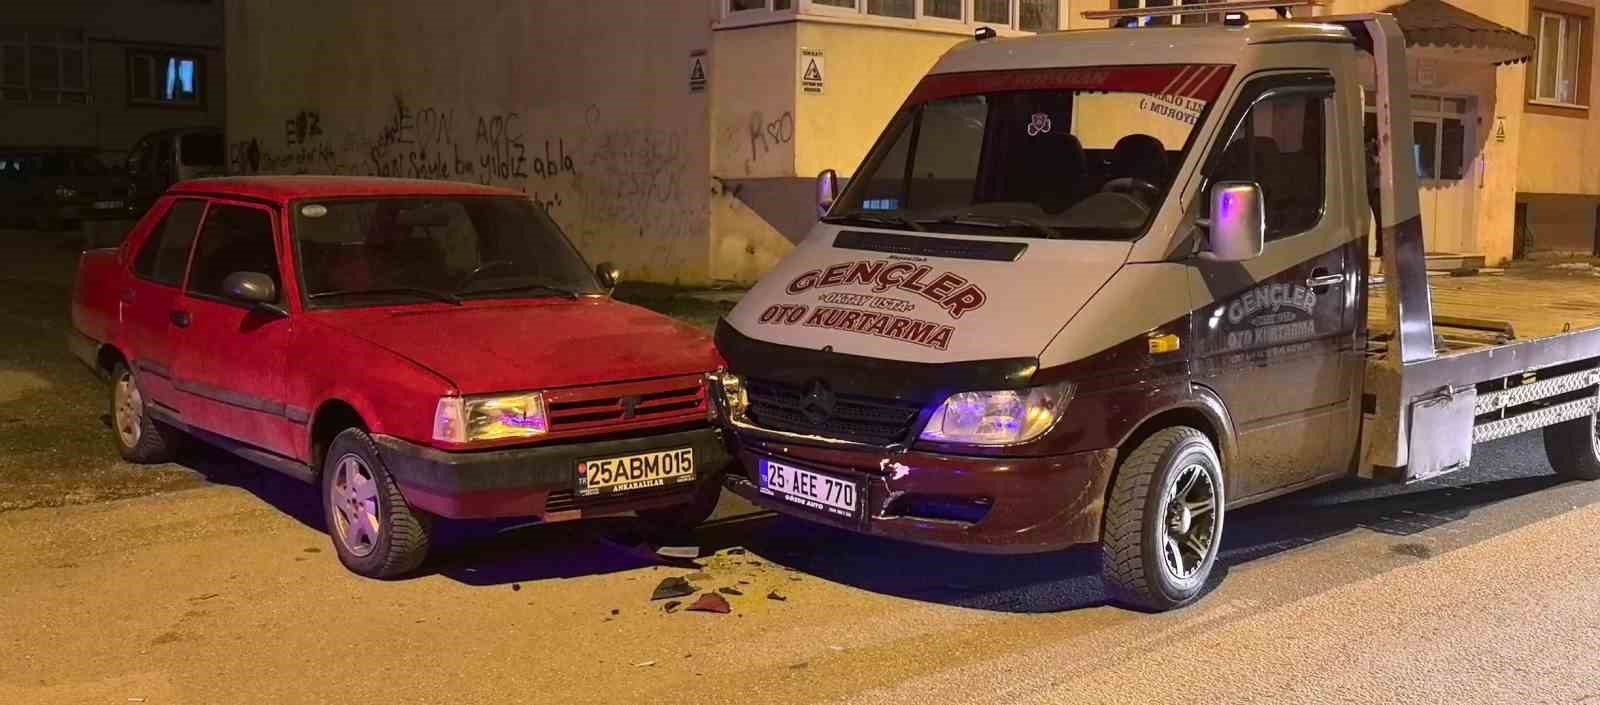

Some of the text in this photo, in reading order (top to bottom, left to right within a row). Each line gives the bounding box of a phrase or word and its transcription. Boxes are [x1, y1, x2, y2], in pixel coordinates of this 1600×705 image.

[533, 138, 576, 179] abla
[786, 260, 987, 319] GENÇLER
[1228, 283, 1317, 325] GENÇLER
[759, 303, 955, 350] OTO KURTARMA
[769, 464, 853, 507] 25 AEE 770
